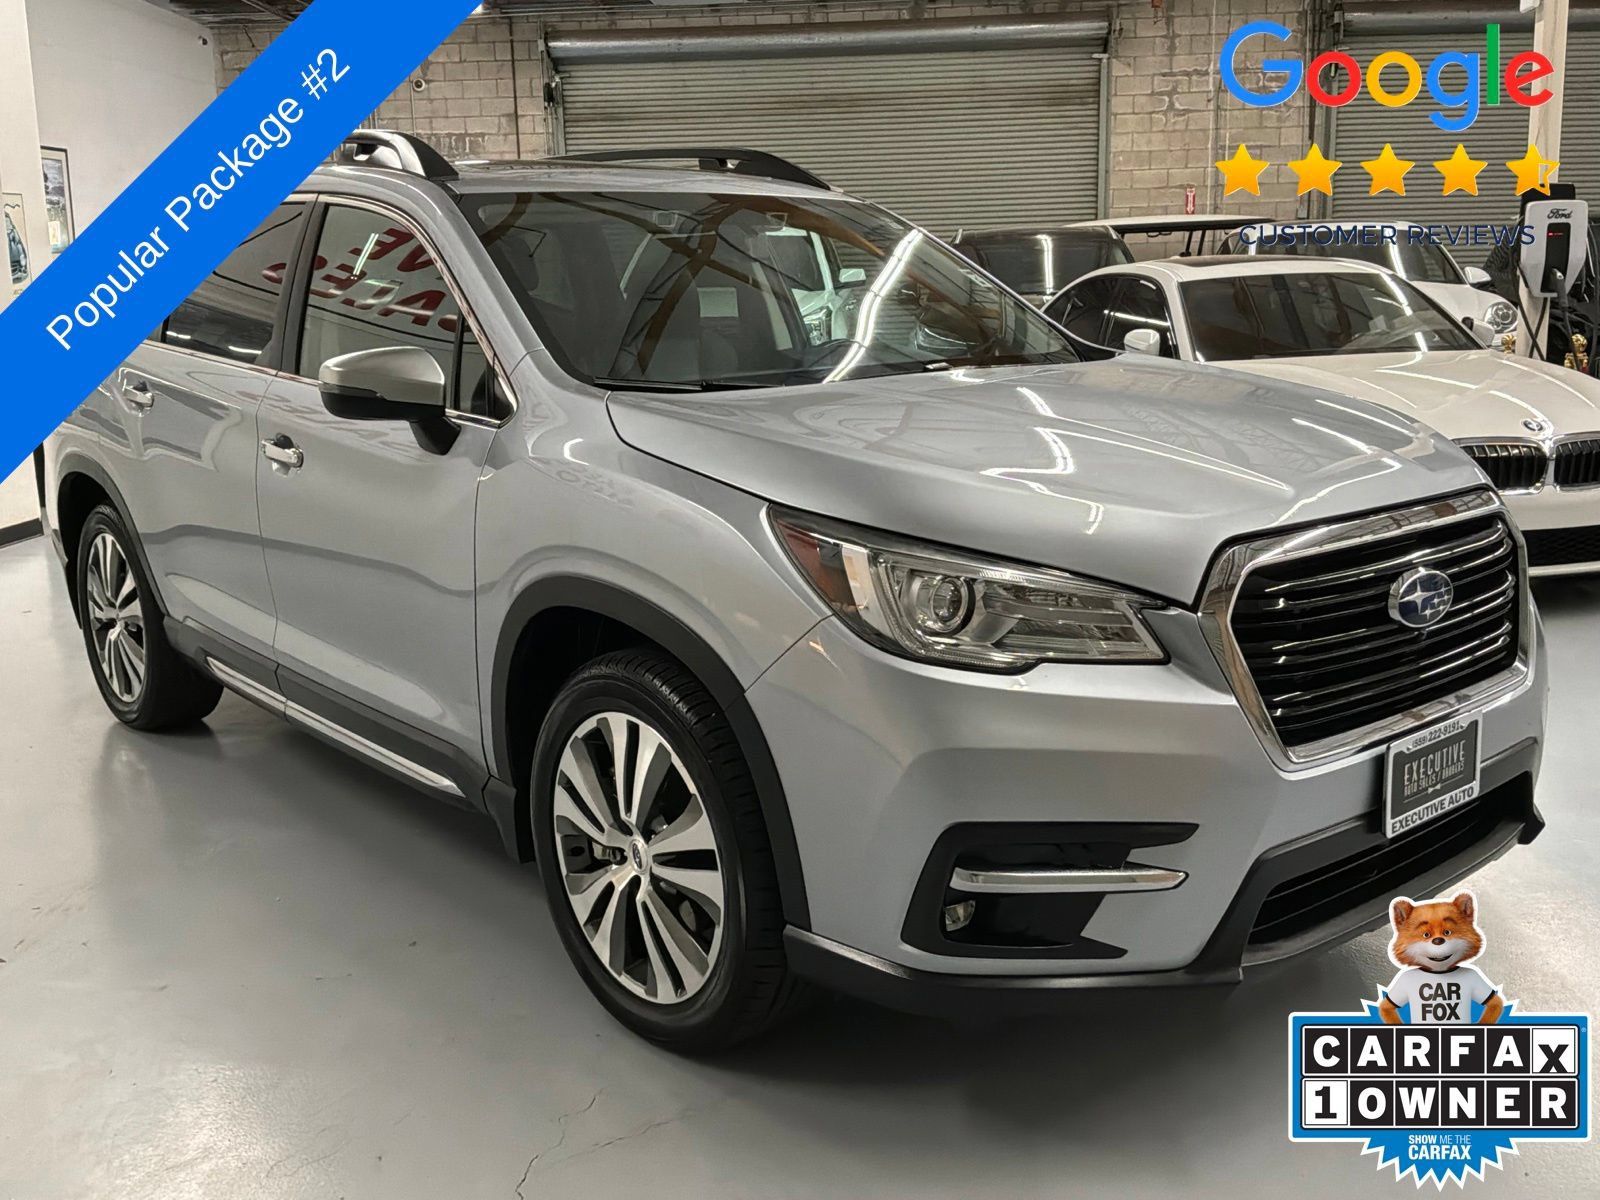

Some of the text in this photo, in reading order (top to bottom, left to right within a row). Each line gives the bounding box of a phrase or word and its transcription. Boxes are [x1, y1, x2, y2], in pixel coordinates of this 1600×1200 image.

[1547, 208, 1573, 220] Ford
[1404, 740, 1466, 785] EXECUTIVE
[1391, 786, 1475, 834] EXECUTIVE AUTO
